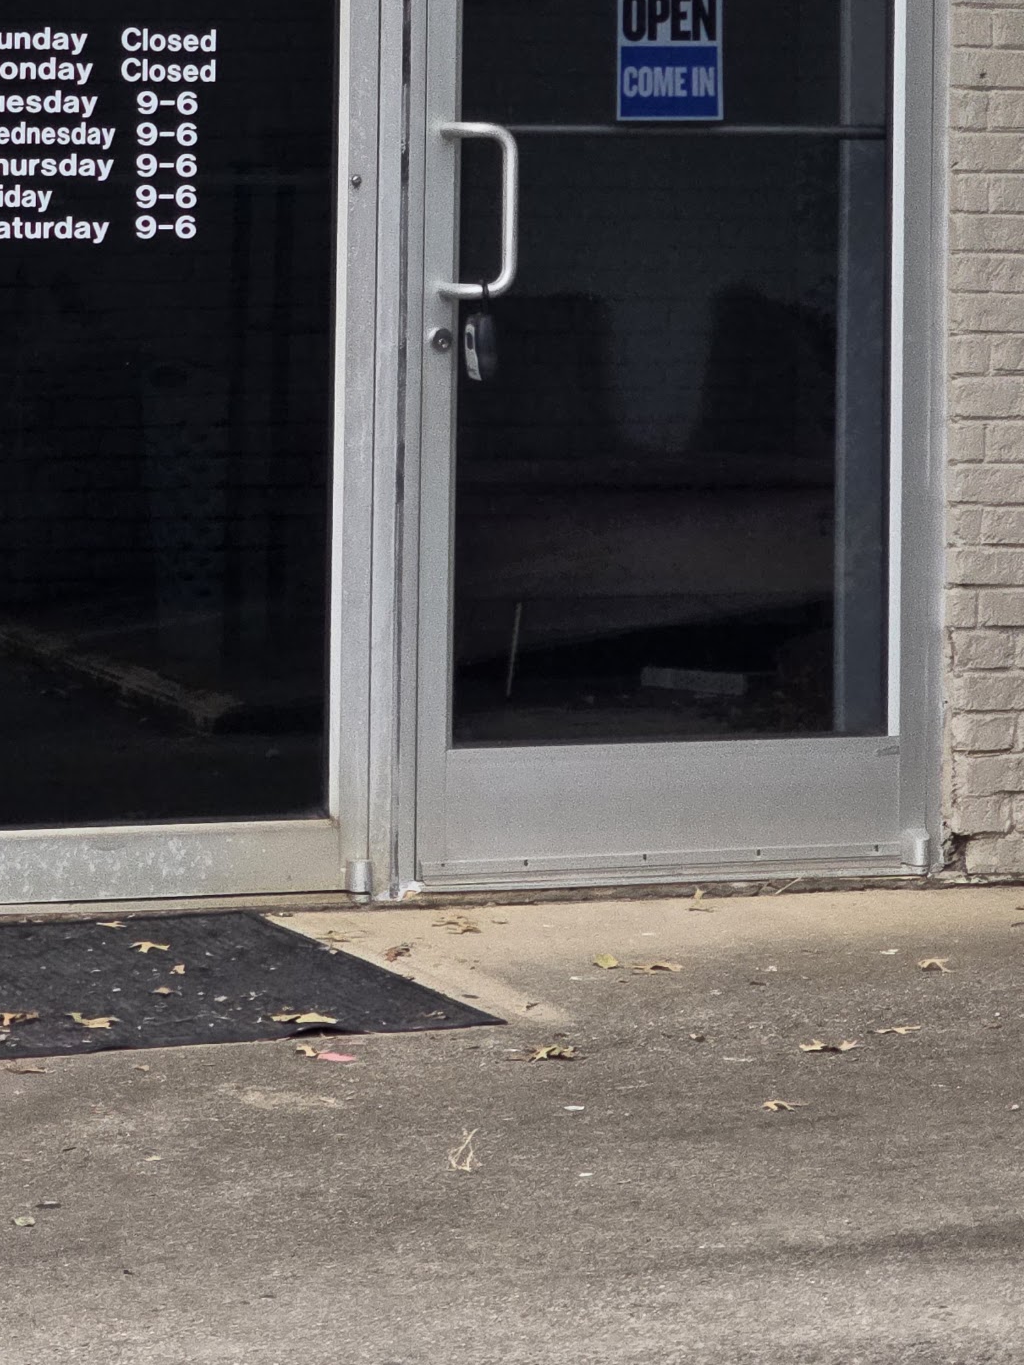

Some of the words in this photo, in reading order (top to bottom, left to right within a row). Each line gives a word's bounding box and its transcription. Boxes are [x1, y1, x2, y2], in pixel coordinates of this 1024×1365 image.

[122, 28, 216, 52] Closed
[121, 58, 216, 83] Closed
[623, 66, 687, 97] COME
[692, 66, 716, 97] IN
[137, 91, 198, 115] 9-6
[136, 122, 198, 147] 9-6
[136, 154, 197, 178] 9-6
[136, 185, 197, 209] 9-6
[135, 215, 197, 240] 9-6
